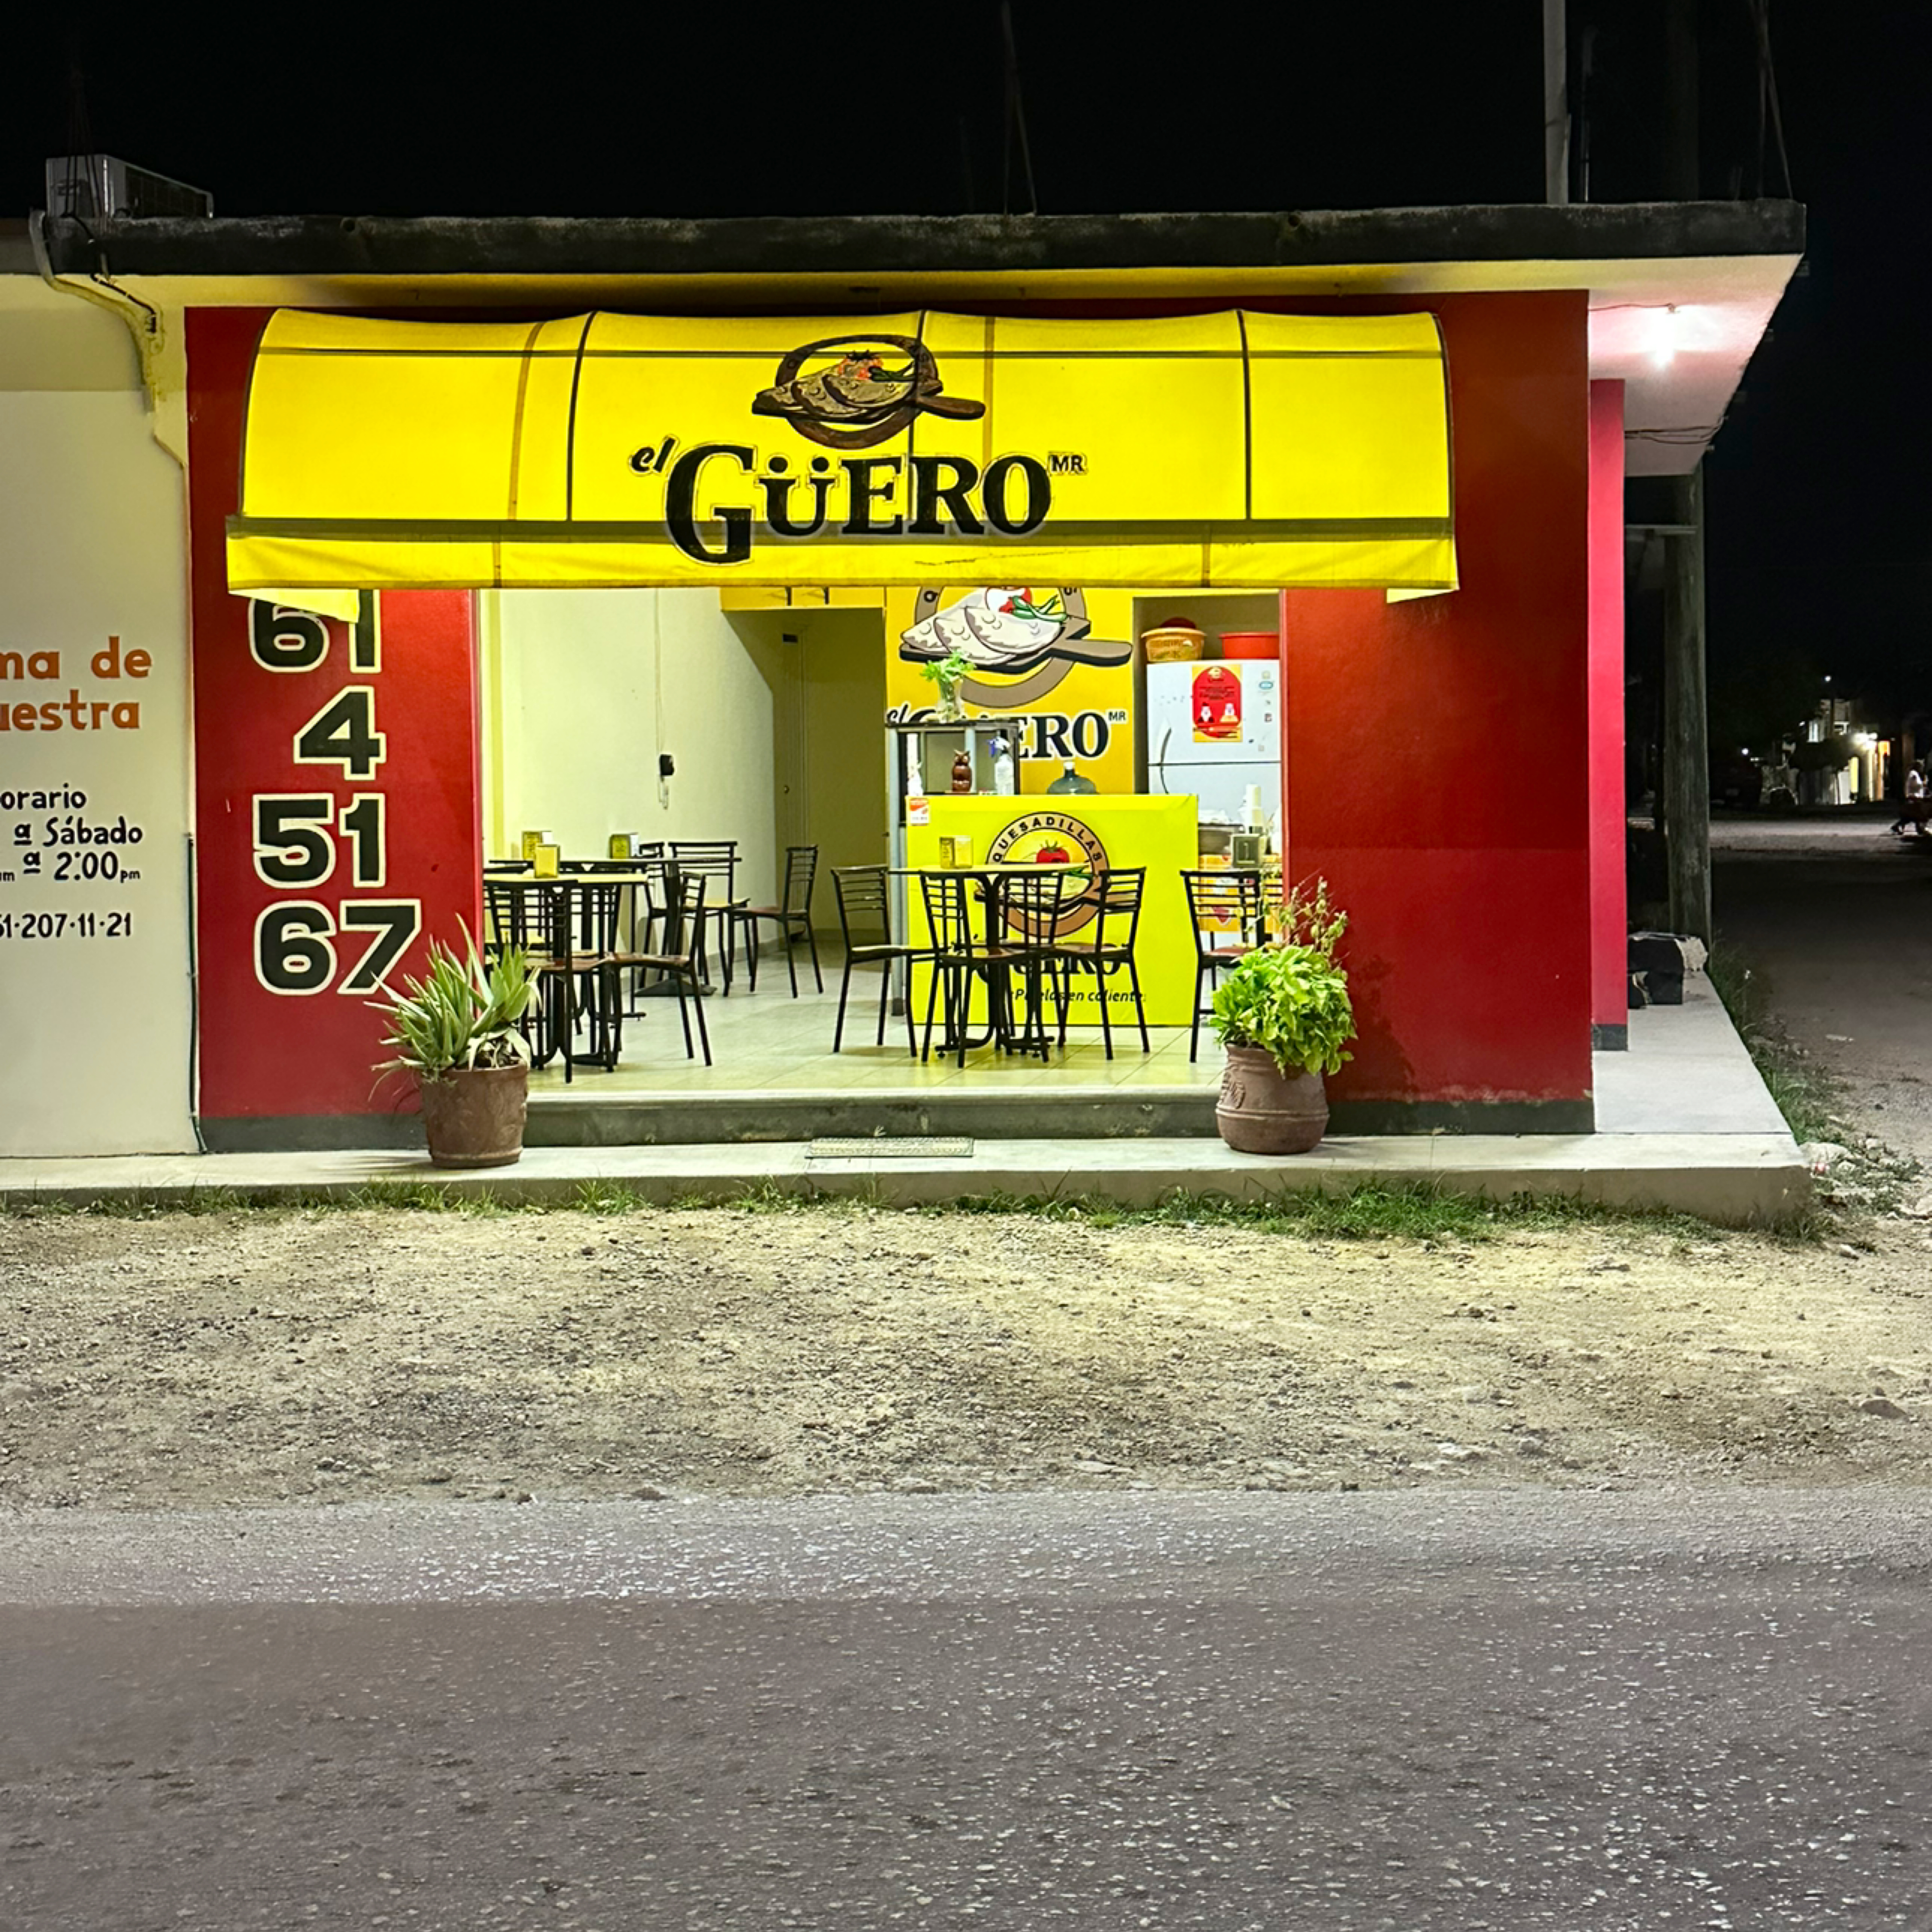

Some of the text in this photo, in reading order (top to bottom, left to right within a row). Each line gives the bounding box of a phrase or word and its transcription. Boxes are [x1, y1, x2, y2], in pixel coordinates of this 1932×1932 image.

[631, 437, 676, 473] el
[1050, 454, 1085, 472] MR
[91, 636, 152, 678] de
[293, 685, 386, 780] 4
[1109, 711, 1126, 722] MR
[42, 815, 143, 847] Sábado
[253, 793, 385, 889] 51
[992, 816, 1102, 862] QUESADILLAS
[254, 899, 421, 995] 67
